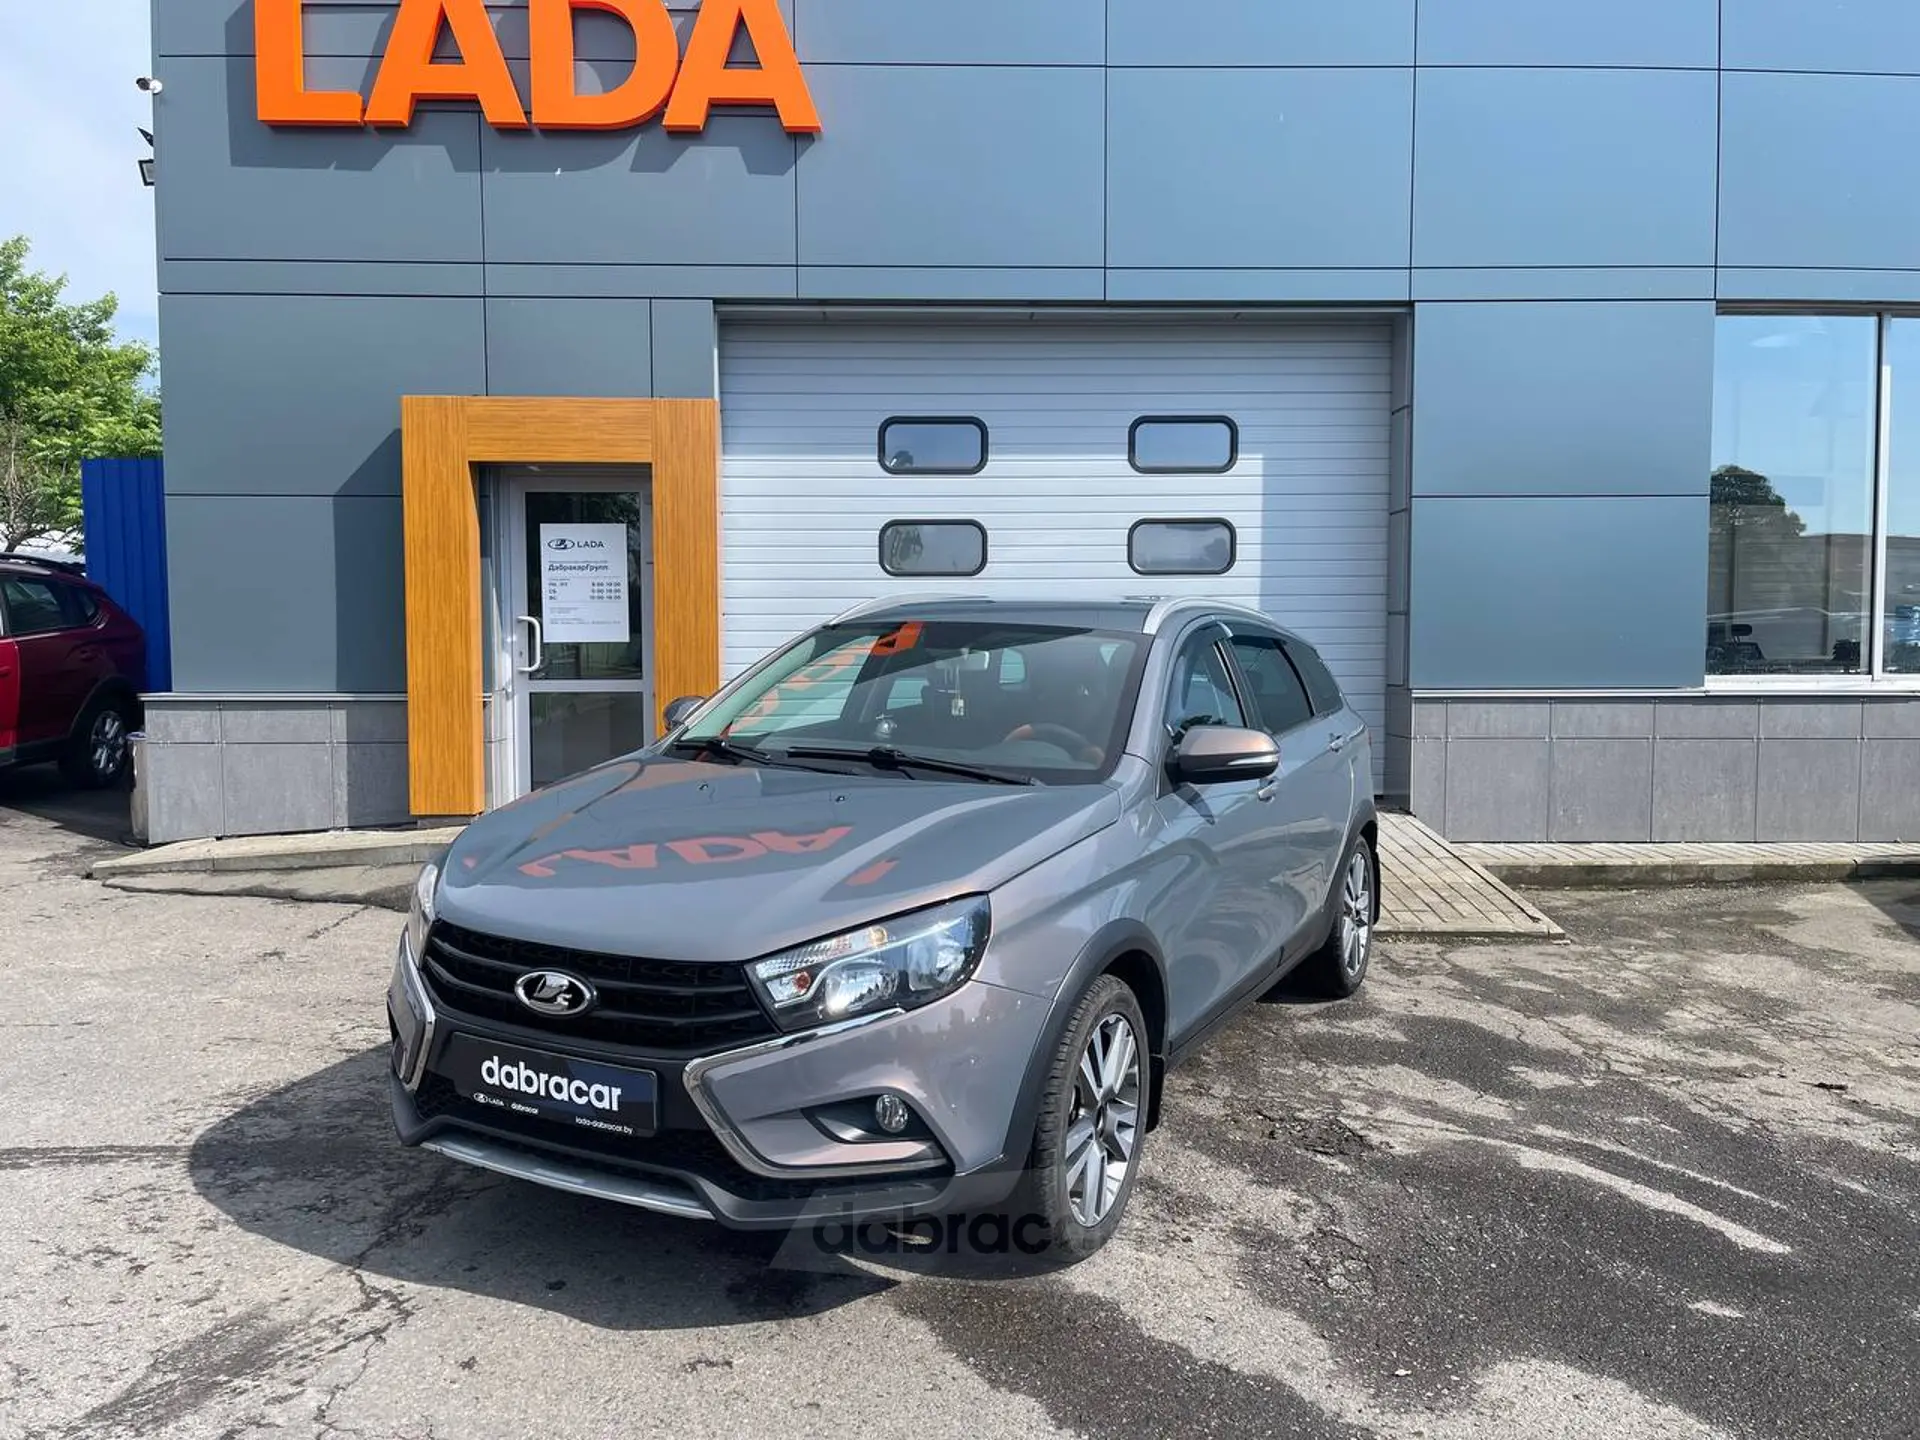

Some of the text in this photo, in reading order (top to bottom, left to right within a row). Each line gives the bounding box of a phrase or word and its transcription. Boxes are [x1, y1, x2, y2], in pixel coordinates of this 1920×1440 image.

[256, 0, 821, 132] LADA
[577, 540, 605, 548] LADA
[480, 1055, 622, 1112] dabracar
